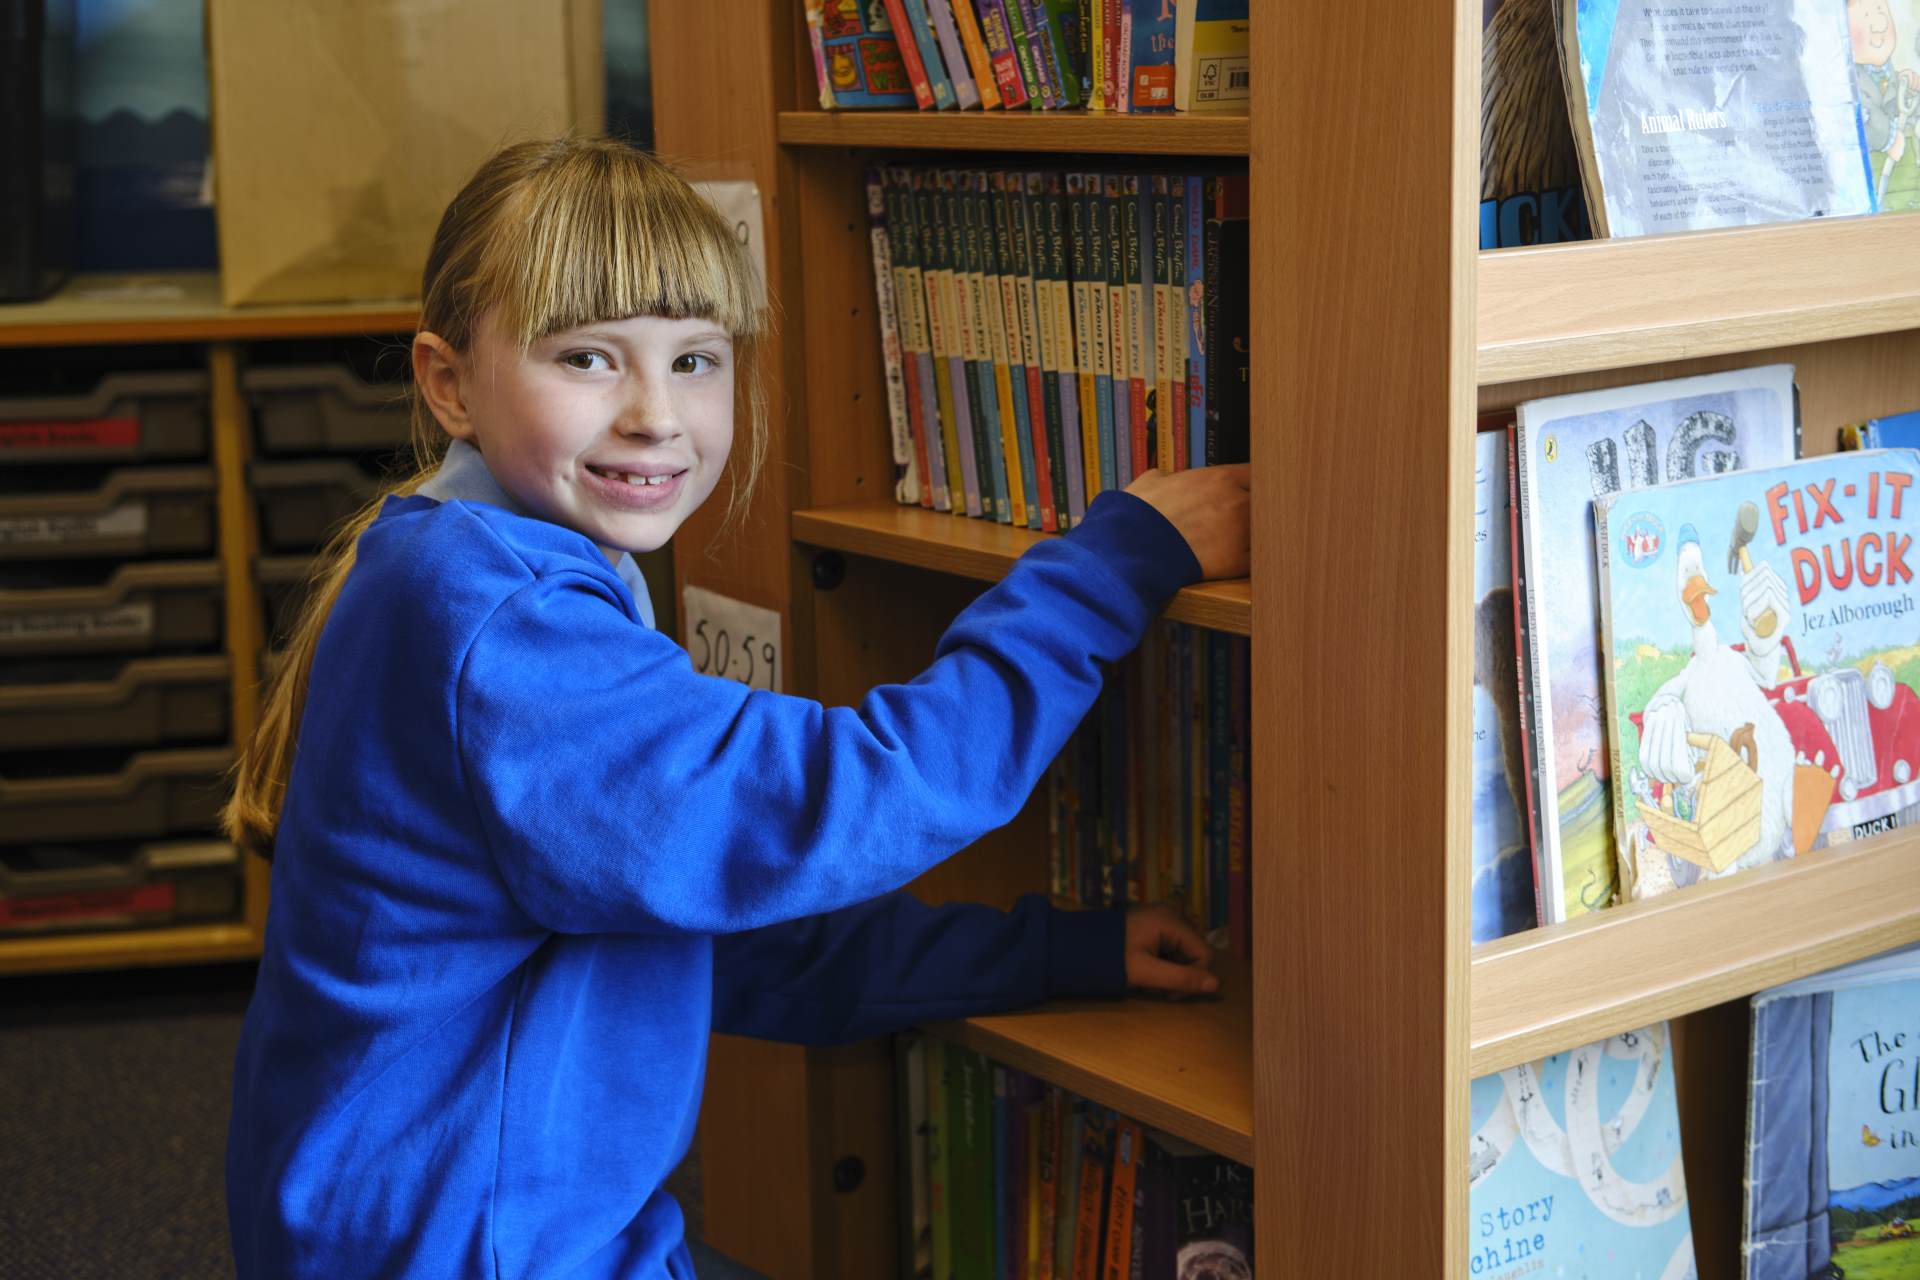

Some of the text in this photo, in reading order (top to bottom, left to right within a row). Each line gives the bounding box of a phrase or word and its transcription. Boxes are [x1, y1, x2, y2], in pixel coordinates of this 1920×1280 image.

[1032, 46, 1046, 83] ORCHARD
[1641, 108, 1685, 134] Animal
[1686, 107, 1728, 130] Rulers
[1157, 290, 1165, 374] FAMOUS FIVE
[1518, 425, 1531, 520] RAYMOND BRIGGS
[1791, 531, 1914, 606] DUCK
[1802, 593, 1915, 637] Jez Alborough
[1850, 1031, 1907, 1063] The
[1480, 1194, 1554, 1237] Story
[1470, 1233, 1545, 1274] chine
